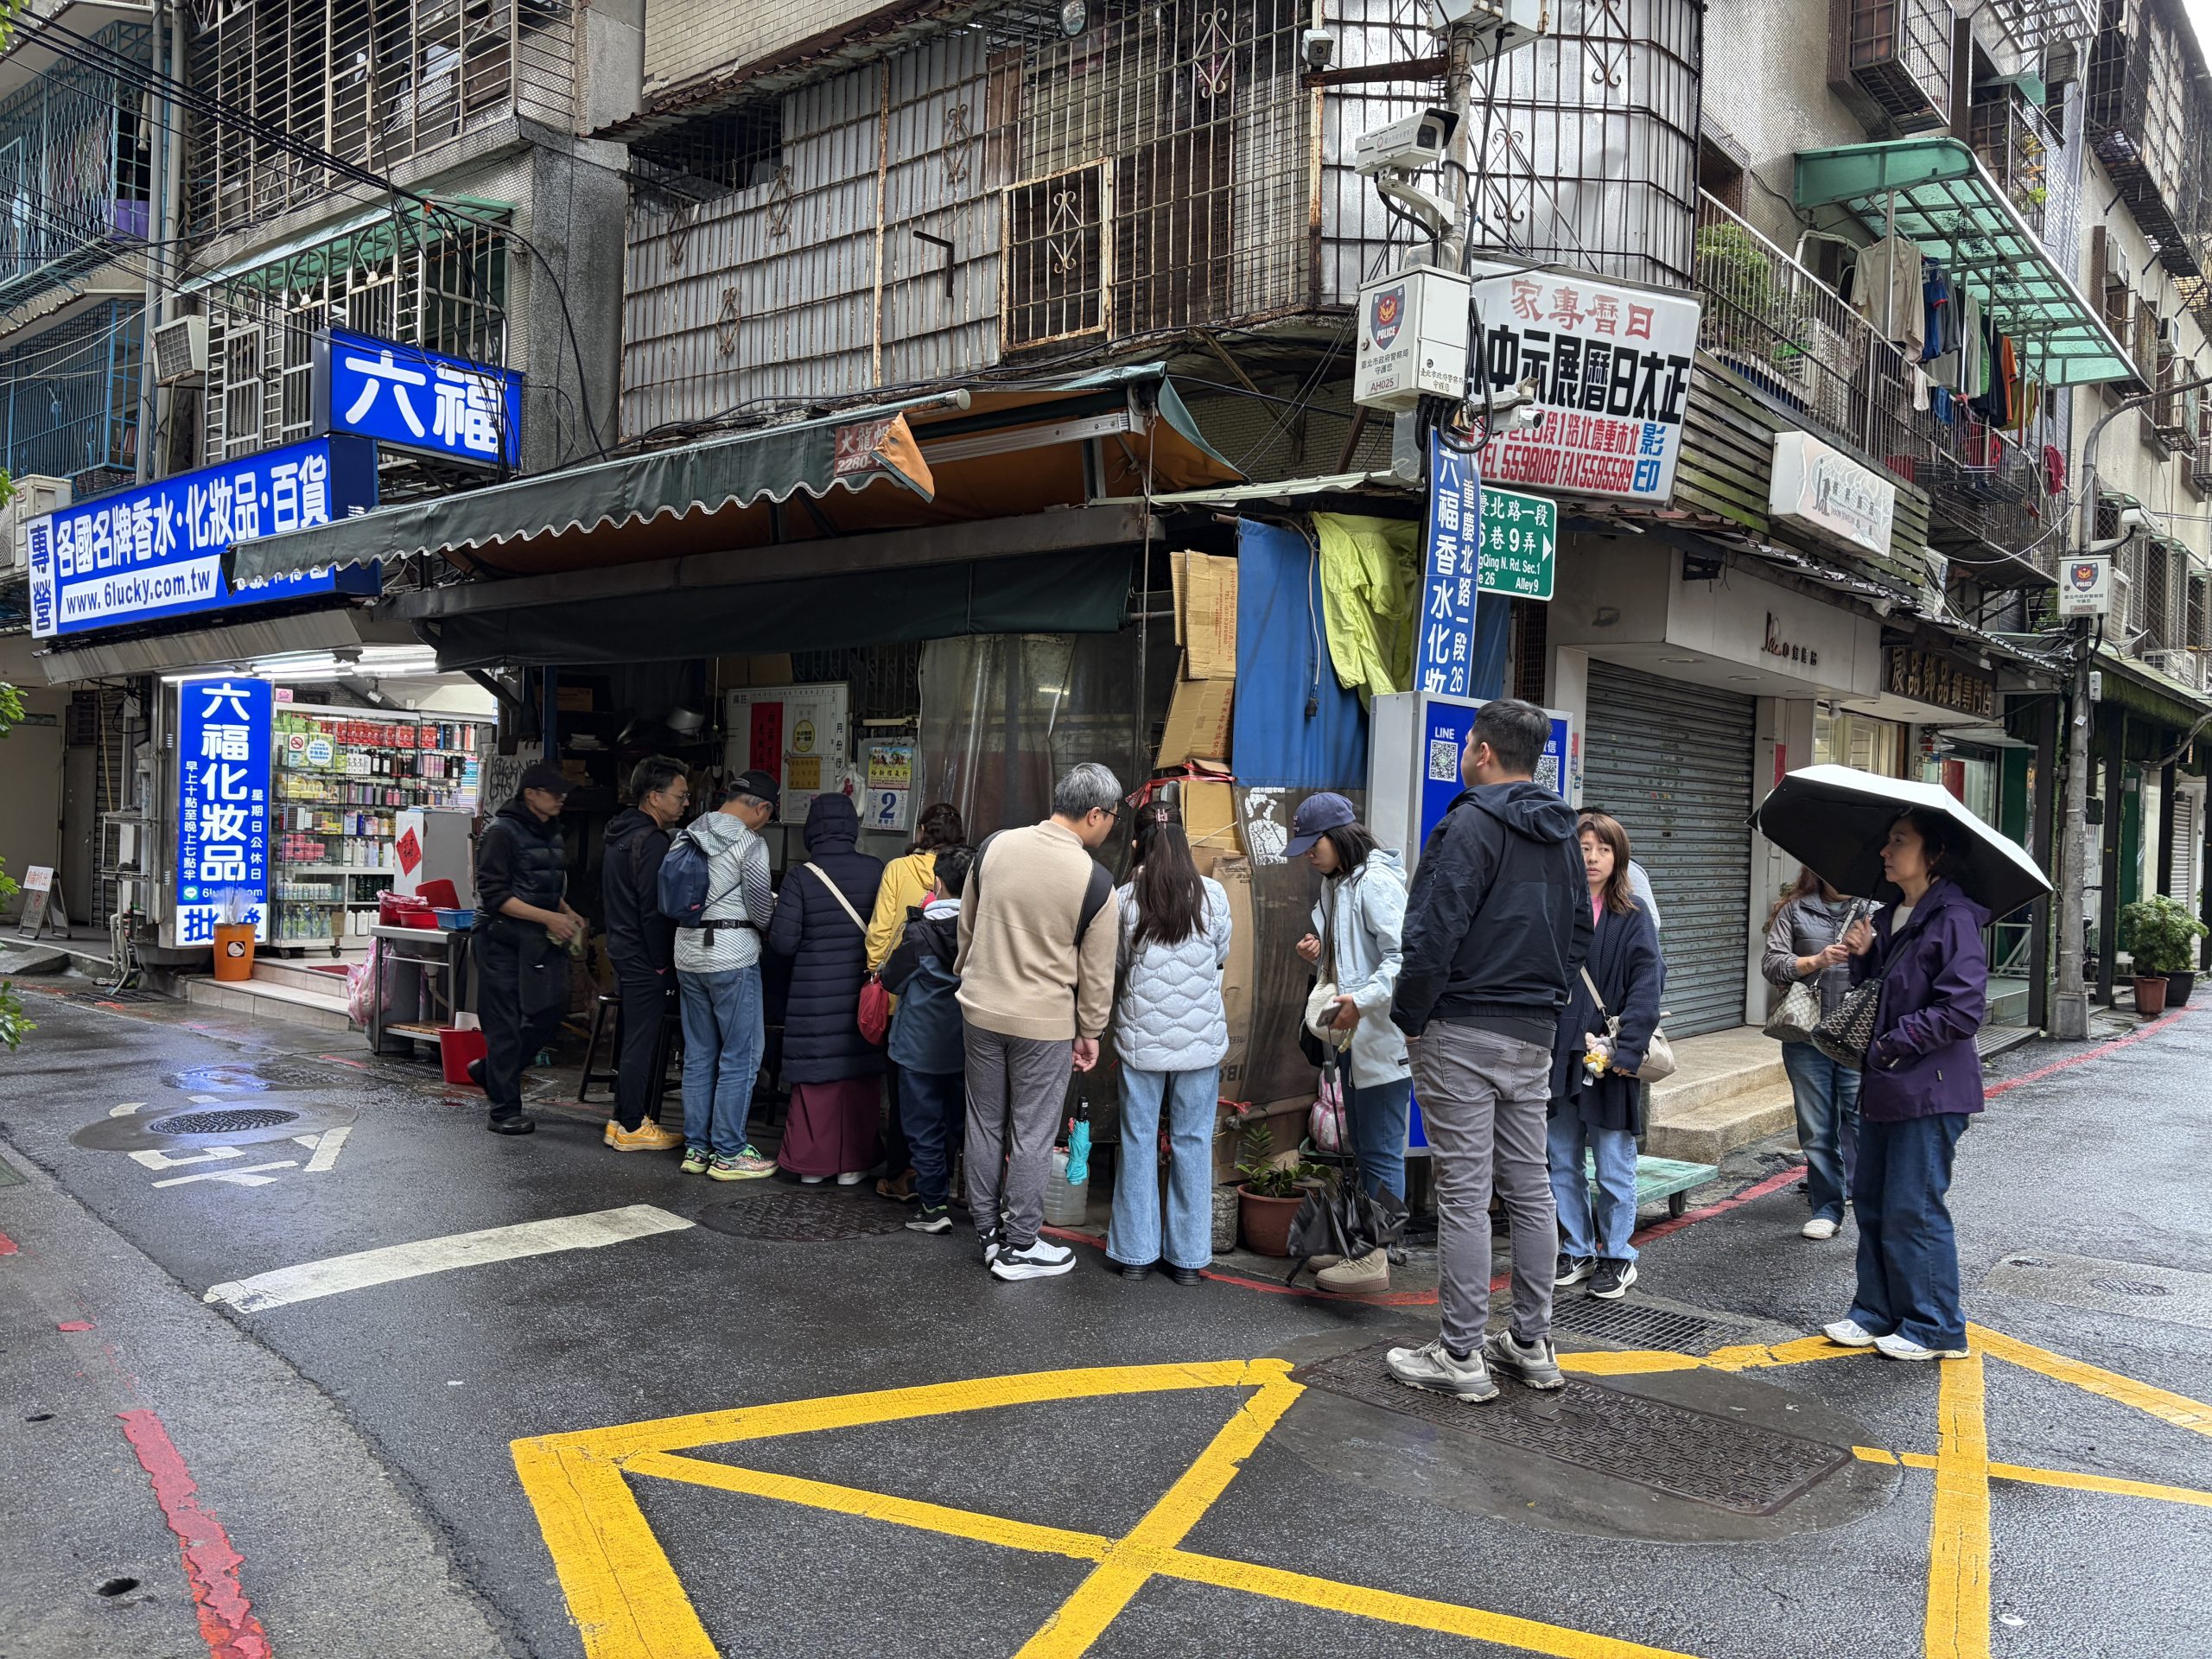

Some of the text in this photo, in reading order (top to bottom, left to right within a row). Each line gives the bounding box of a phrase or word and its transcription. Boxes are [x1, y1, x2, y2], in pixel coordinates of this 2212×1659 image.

[1376, 326, 1396, 340] POLICE
[1361, 349, 1409, 370] 臺北市政府警察局
[1375, 363, 1393, 375] 守護您
[1370, 378, 1395, 392] AH025
[346, 349, 504, 452] 六福
[836, 454, 880, 474] 2280-
[1501, 444, 1560, 485] 5598108
[1632, 423, 1666, 493] 影印
[1500, 556, 1508, 570] N.
[1510, 557, 1521, 572] Rd.
[29, 524, 52, 632] 專營
[1434, 727, 1455, 740] LINE
[200, 682, 251, 882] 六福化妝品
[879, 792, 897, 819] 2
[183, 760, 199, 880] 早上十點至晚上七點半
[251, 789, 264, 880] 星期日公休日
